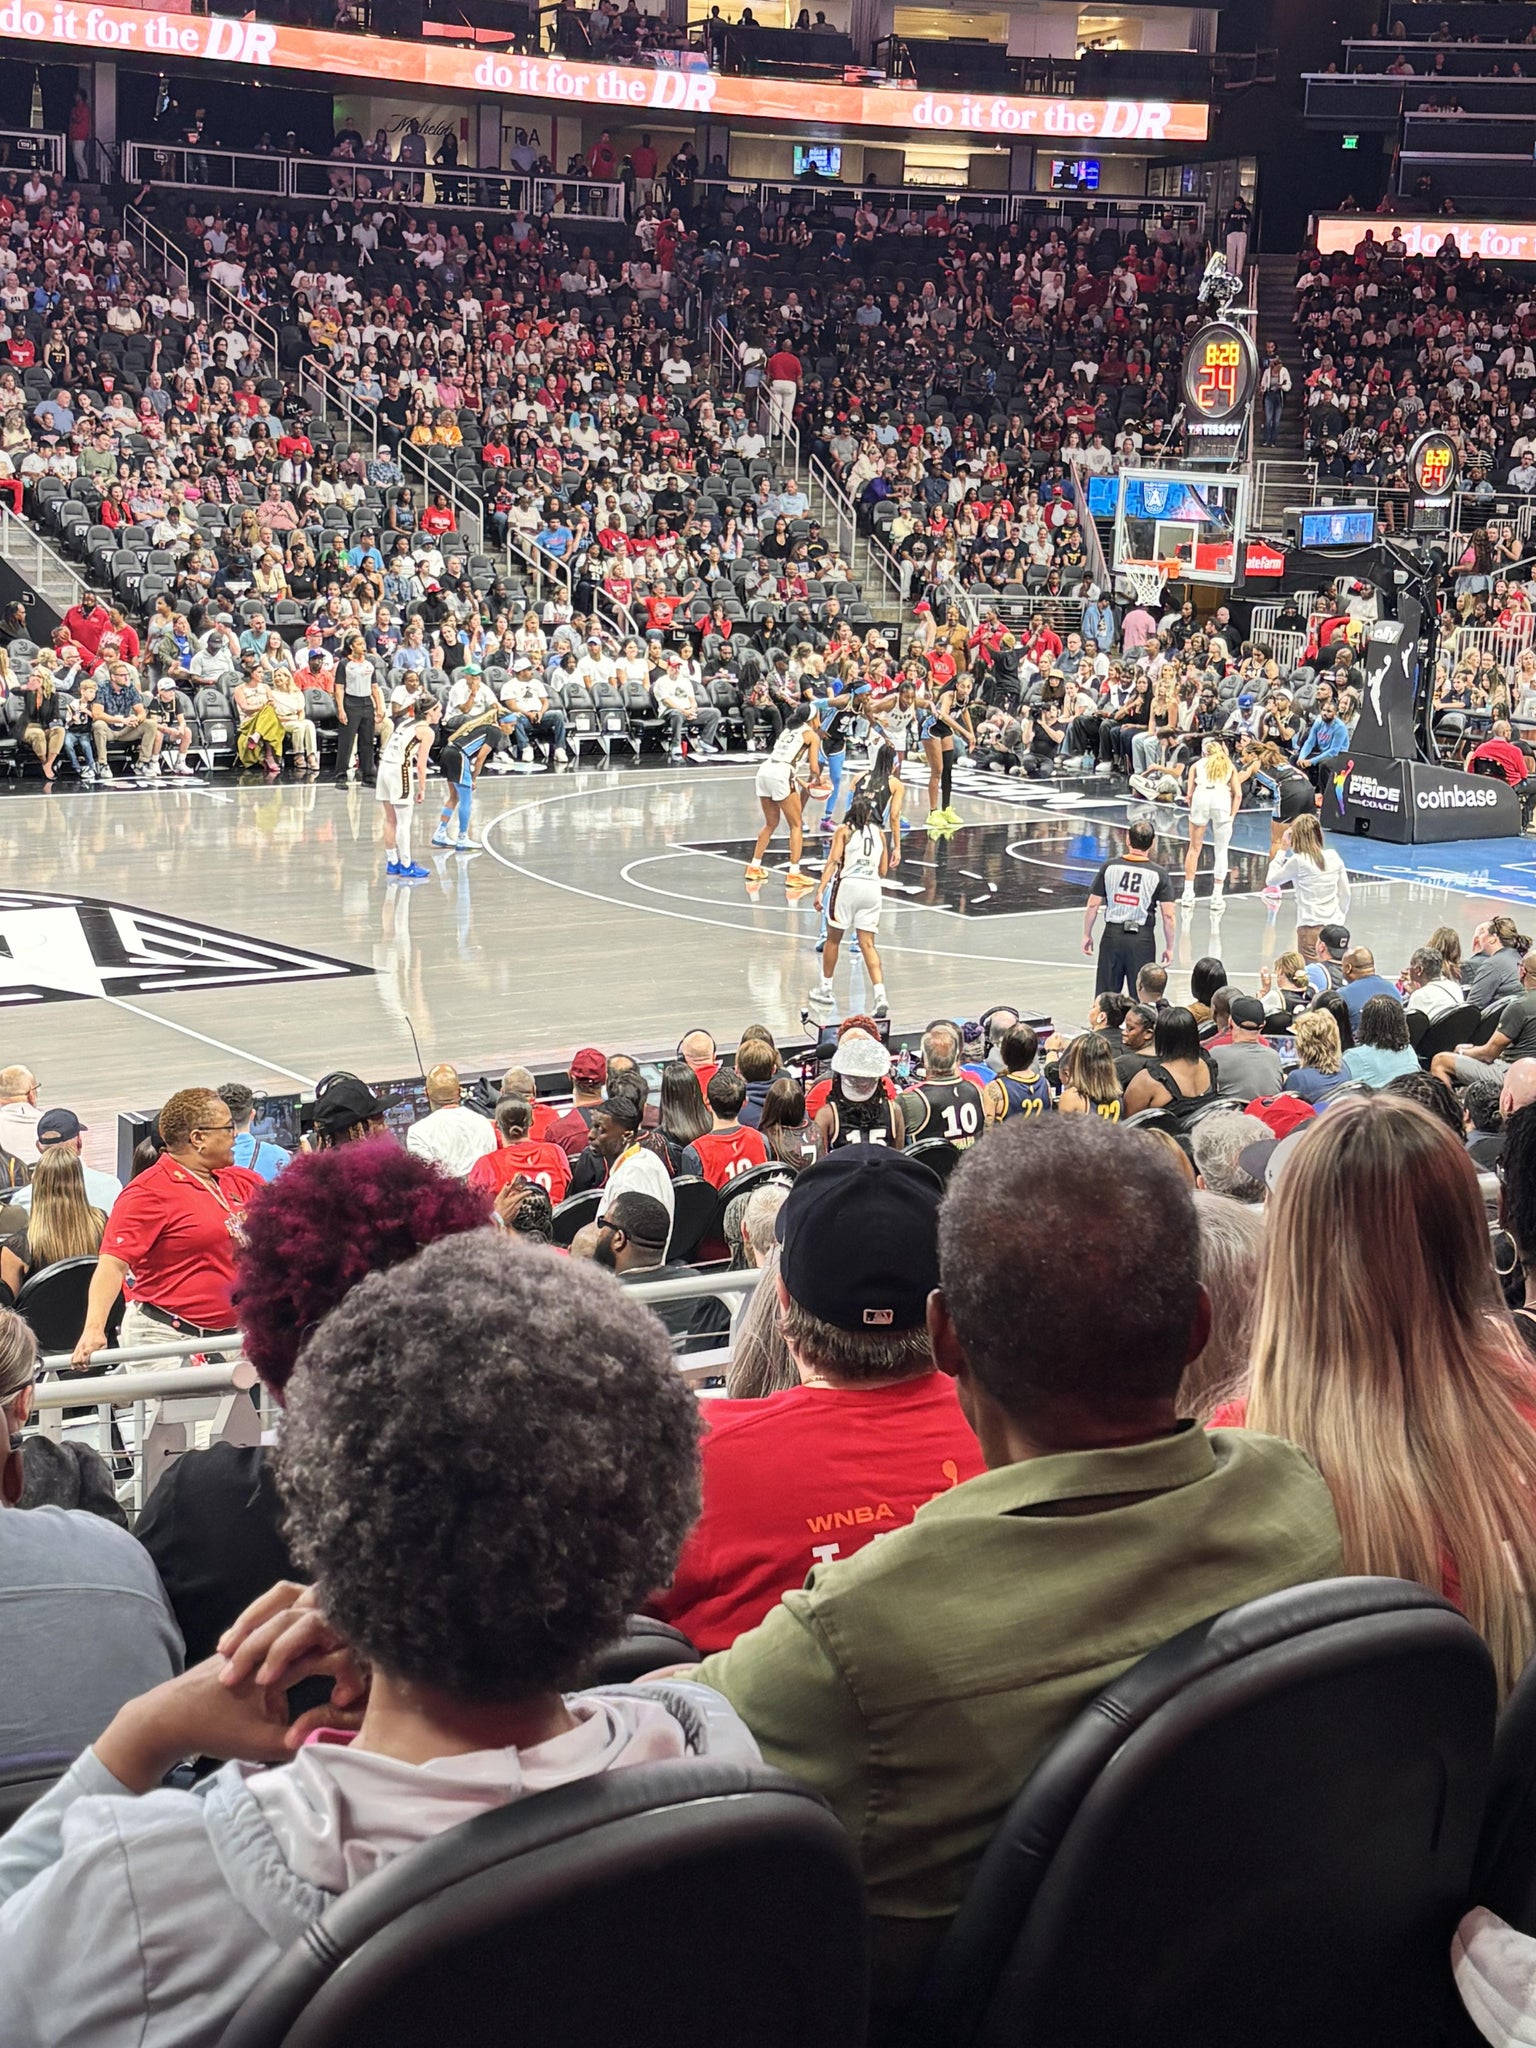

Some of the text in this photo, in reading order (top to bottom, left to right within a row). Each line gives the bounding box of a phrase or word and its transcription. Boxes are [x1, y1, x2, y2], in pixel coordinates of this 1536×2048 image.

[0, 0, 276, 65] do it for the DR
[474, 55, 716, 112] do it for the DR
[913, 95, 1171, 139] do it for the DR
[1403, 226, 1441, 253] do
[1479, 227, 1527, 256] for
[1206, 343, 1240, 366] 8:28
[1197, 366, 1237, 408] 24
[1203, 424, 1241, 436] TISSOT
[1425, 449, 1450, 466] 8:28
[1422, 467, 1444, 487] 24
[1374, 626, 1399, 643] ally
[1349, 781, 1400, 802] PRIDE
[1351, 774, 1378, 786] WNBA
[1361, 799, 1399, 812] COACH
[1416, 784, 1498, 810] coinbase
[1119, 871, 1142, 893] 42
[942, 1102, 977, 1137] 10
[806, 1503, 895, 1533] WNBA
